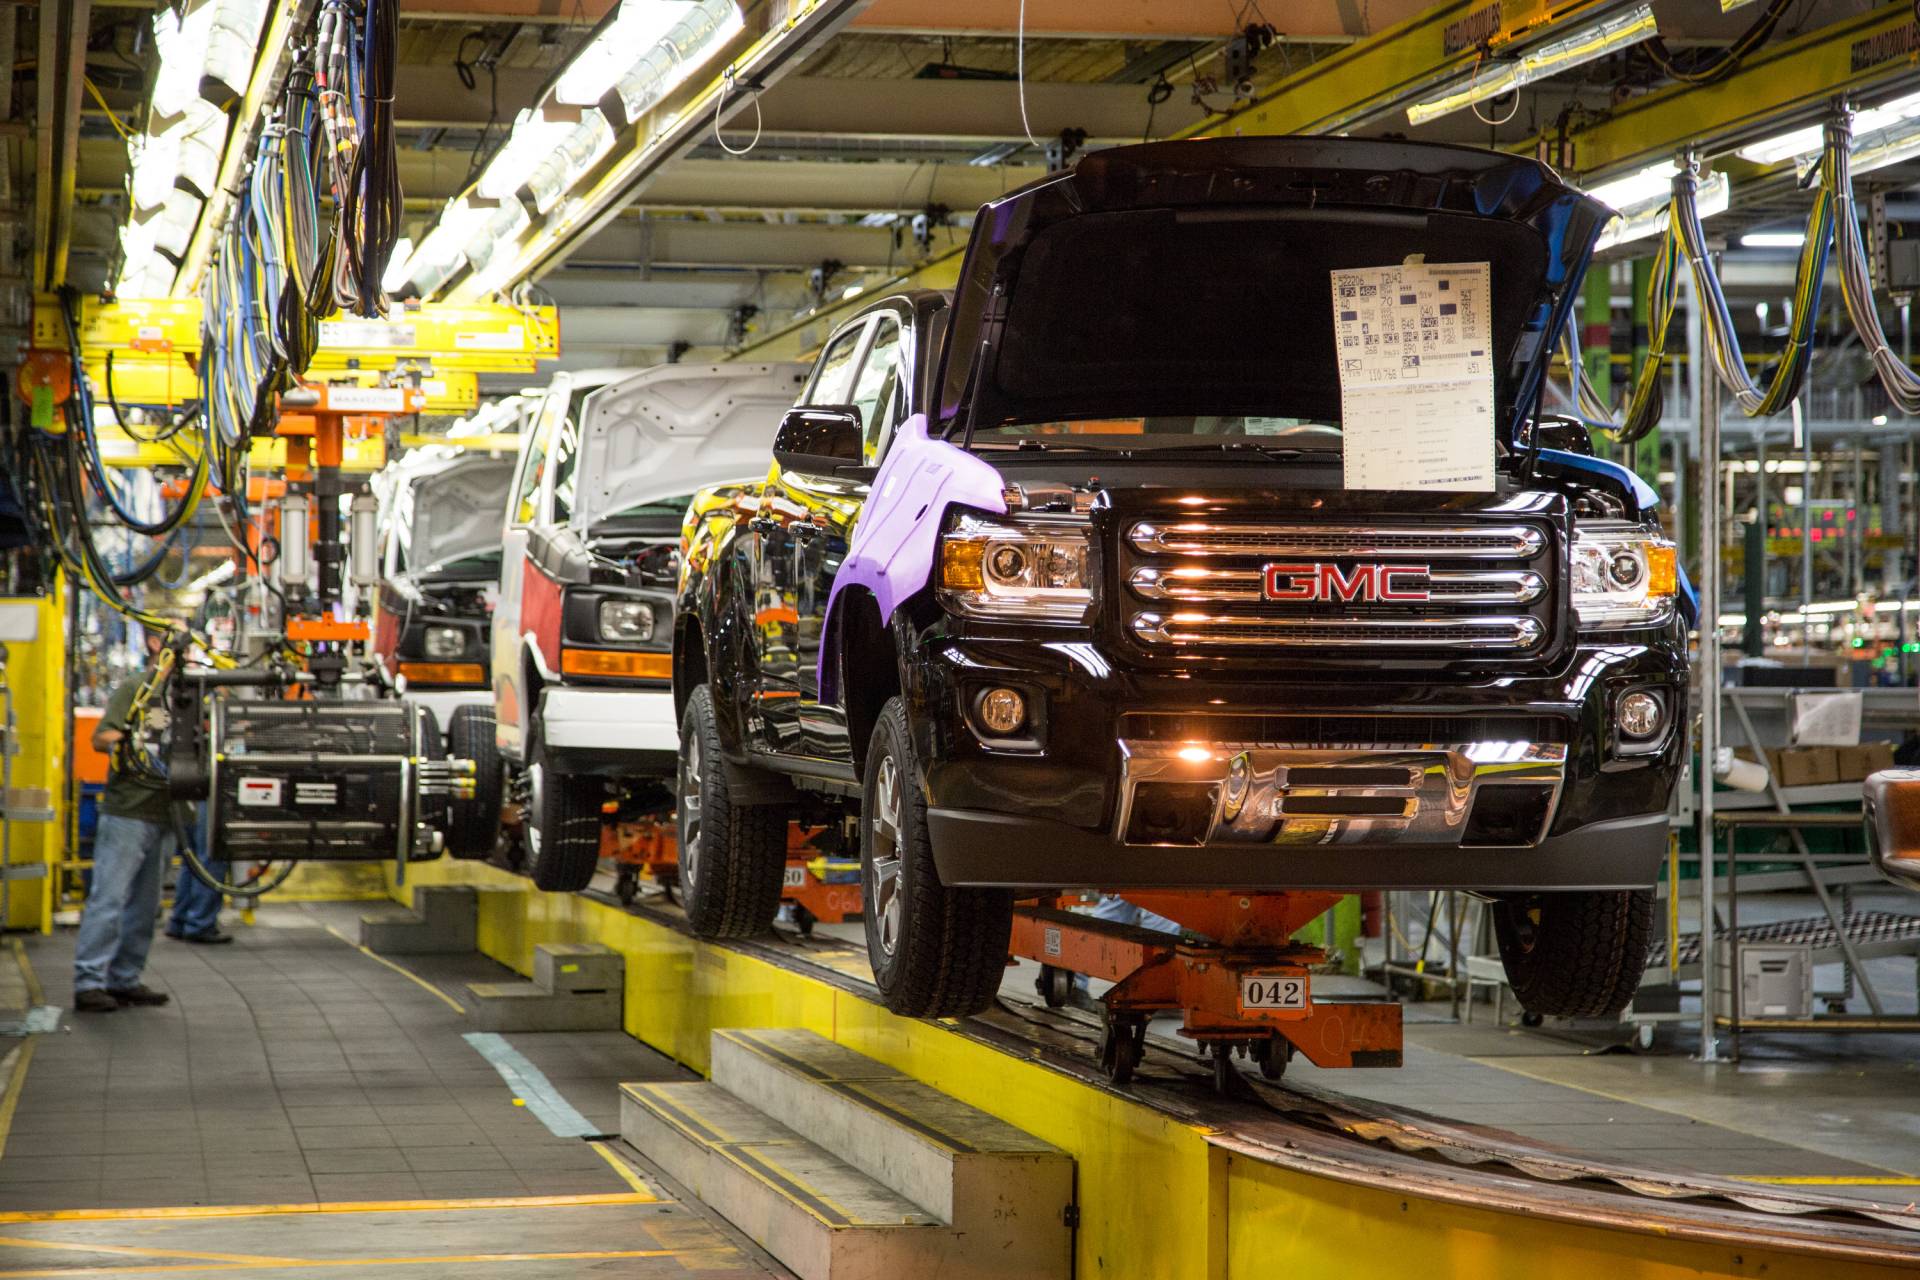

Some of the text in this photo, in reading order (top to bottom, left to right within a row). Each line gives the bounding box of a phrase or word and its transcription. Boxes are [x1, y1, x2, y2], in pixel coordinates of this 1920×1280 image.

[1381, 297, 1393, 307] 70
[1262, 563, 1430, 601] GMC
[1248, 982, 1299, 1004] 042
